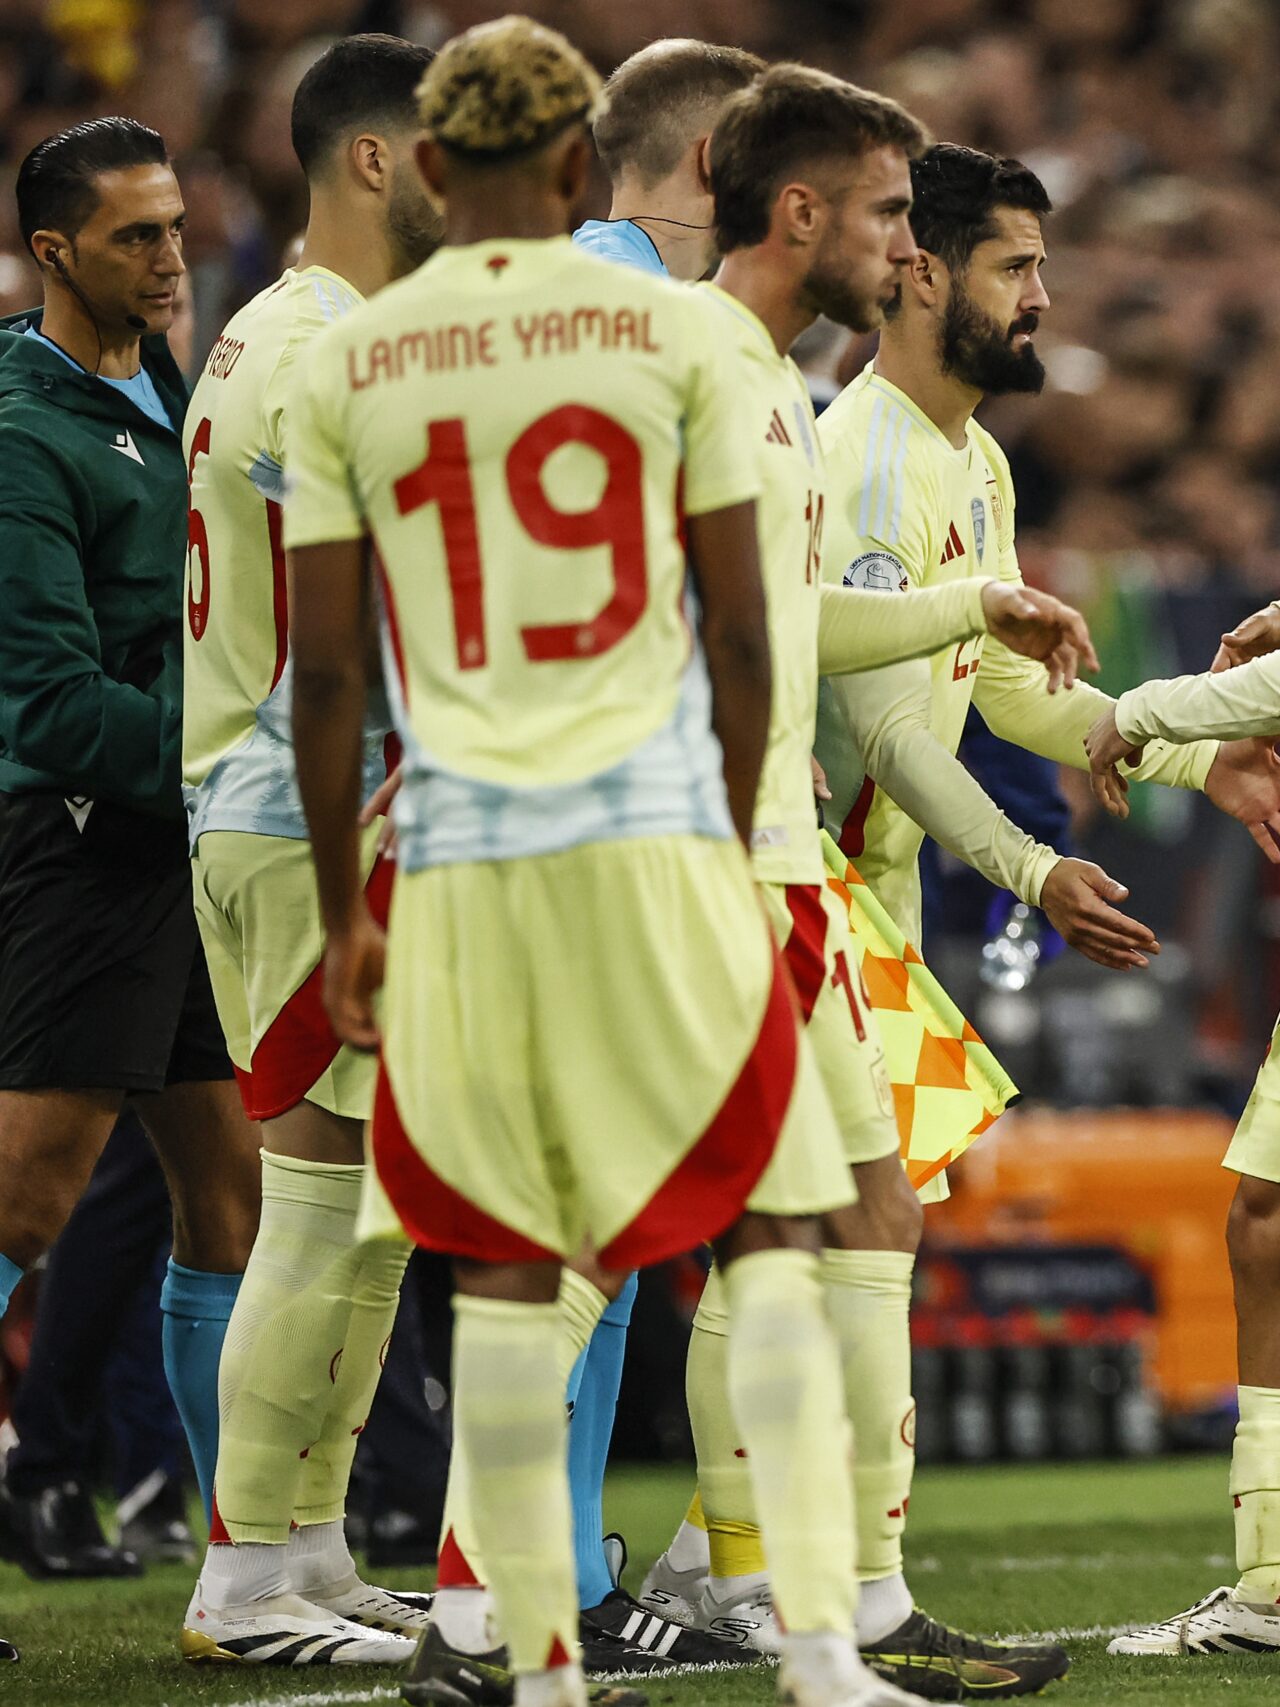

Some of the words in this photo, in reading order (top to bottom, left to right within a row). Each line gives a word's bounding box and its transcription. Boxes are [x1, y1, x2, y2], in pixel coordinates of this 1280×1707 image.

[347, 320, 497, 392] LAMINE
[513, 307, 662, 360] YAMAL
[393, 400, 650, 671] 19
